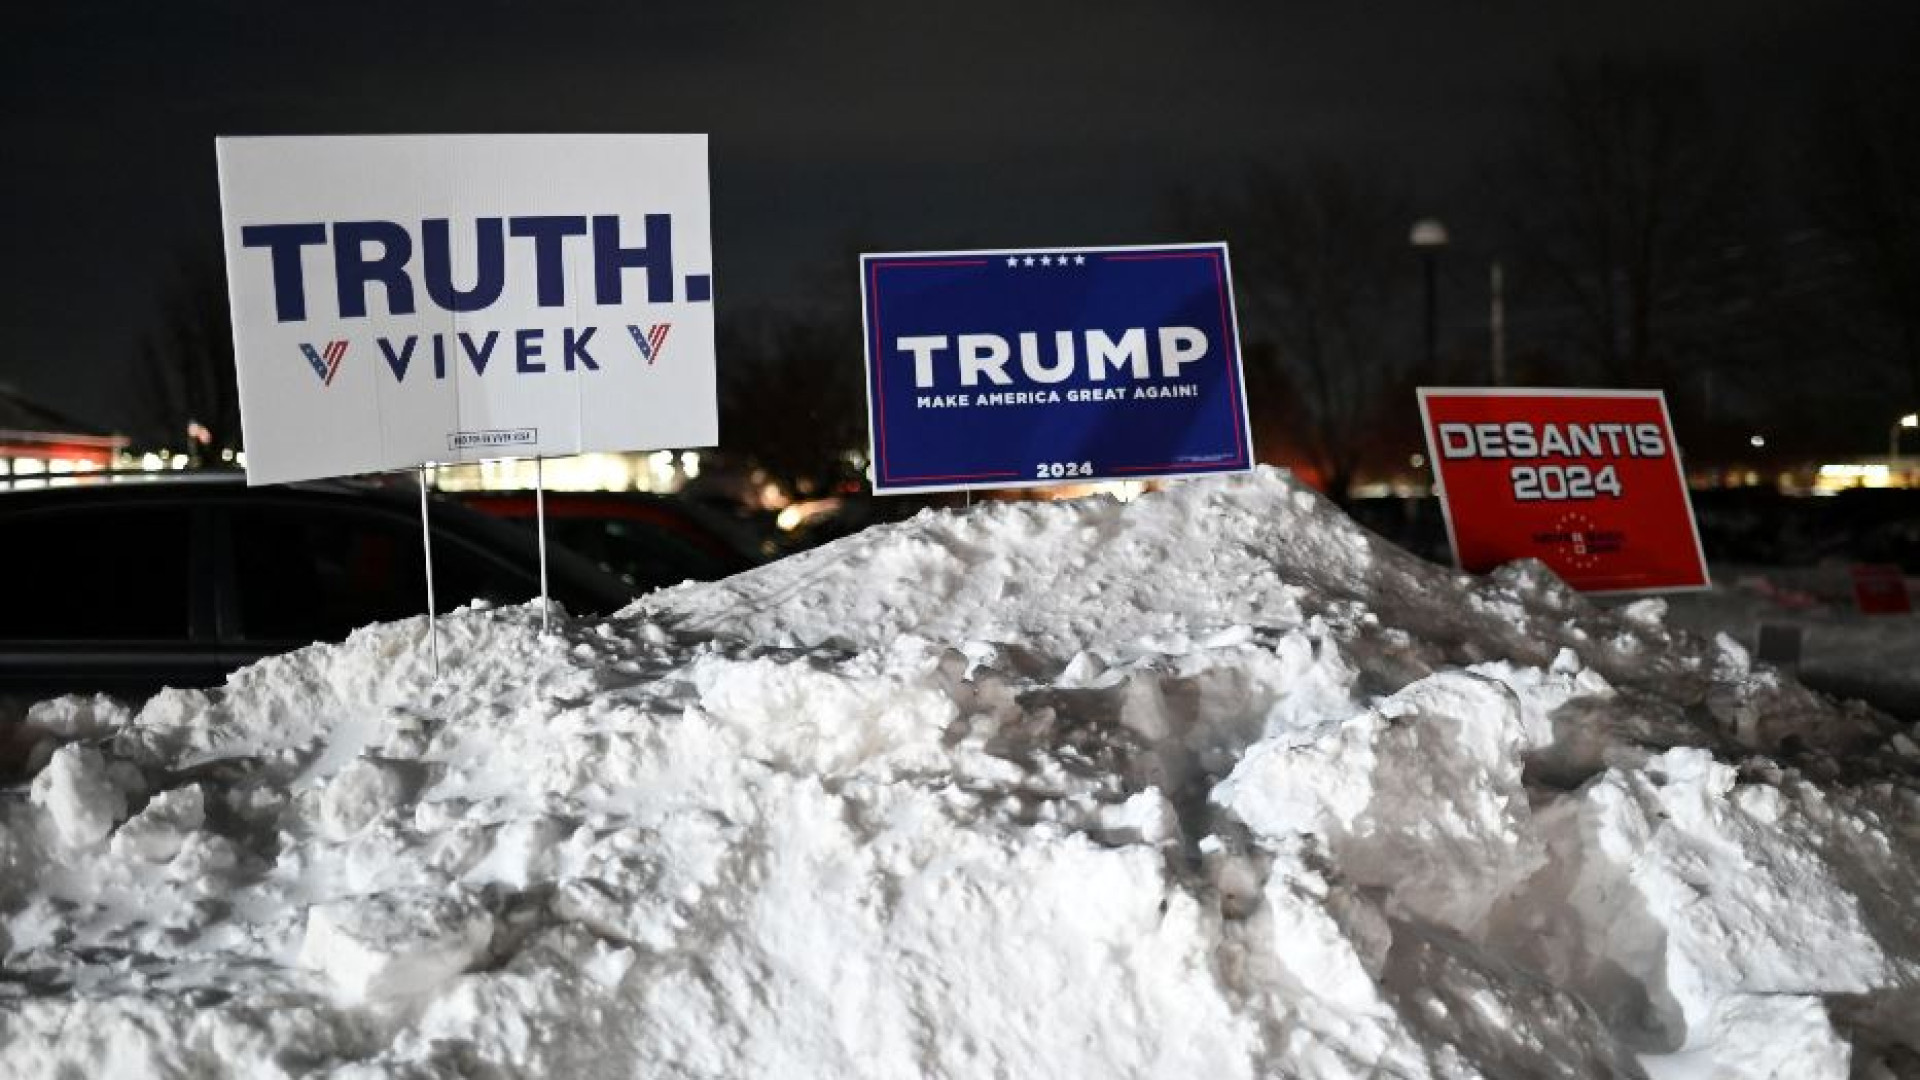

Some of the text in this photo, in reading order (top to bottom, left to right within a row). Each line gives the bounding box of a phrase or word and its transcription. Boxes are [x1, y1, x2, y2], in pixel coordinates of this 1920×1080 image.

[241, 214, 711, 323] TRUTH.
[377, 327, 600, 383] VIVEK
[897, 327, 1209, 387] TRUMP
[917, 385, 1199, 408] MAKE AMERICA GREAT AGAIN!
[1438, 422, 1666, 459] DESANTIS
[1036, 462, 1094, 478] 2024
[1511, 464, 1623, 500] 2024
